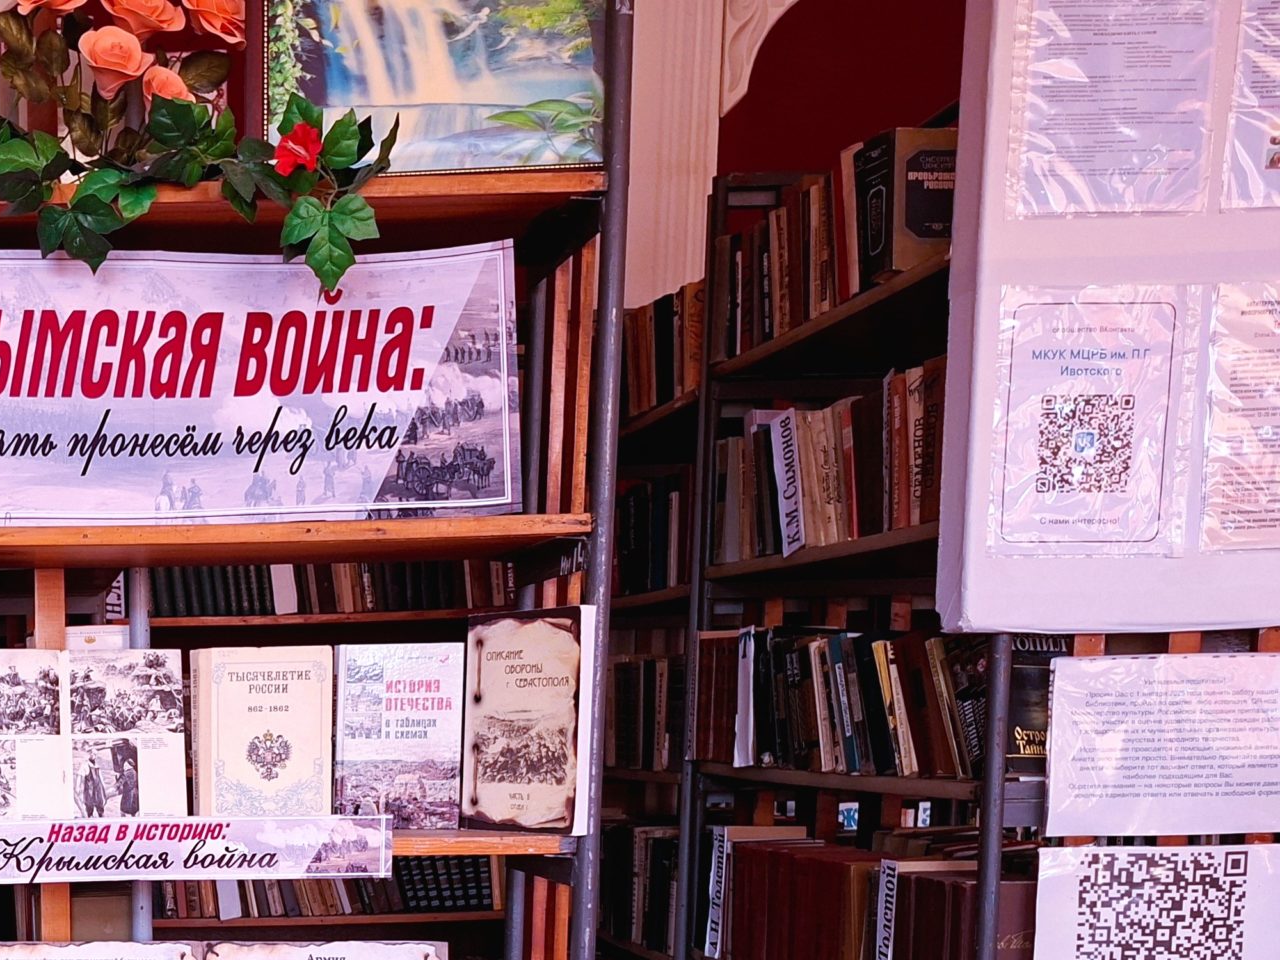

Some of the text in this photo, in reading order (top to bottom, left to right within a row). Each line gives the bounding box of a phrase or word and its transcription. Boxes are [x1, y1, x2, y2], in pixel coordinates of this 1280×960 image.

[232, 288, 436, 397] война:
[1032, 349, 1066, 359] МКУК
[1070, 349, 1107, 361] МЦРБ
[67, 408, 224, 475] пронесём
[234, 405, 316, 475] через
[324, 402, 399, 451] века
[913, 416, 924, 498] СЕМЕНОВ
[781, 415, 801, 546] К.М. Симонов
[1040, 517, 1046, 525] С
[486, 650, 523, 661] ОПИСАНИЕ
[227, 669, 311, 682] ТЫСЯЧЕЛЕТИЕ
[505, 664, 542, 674] ОБОРОНЫ
[385, 679, 440, 693] ИСТОРИЯ
[515, 676, 569, 688] СЕВАСТОПОЛЯ
[248, 683, 288, 695] РОССИИ
[247, 704, 289, 713] 862-1862
[385, 696, 452, 711] ОТЕЧЕСТВА
[385, 717, 437, 729] в таблицах
[385, 729, 428, 740] и схемах
[47, 821, 230, 846] Назад в историю:
[183, 841, 278, 870] война
[712, 832, 724, 909] Толстой
[878, 865, 896, 960] Толстой
